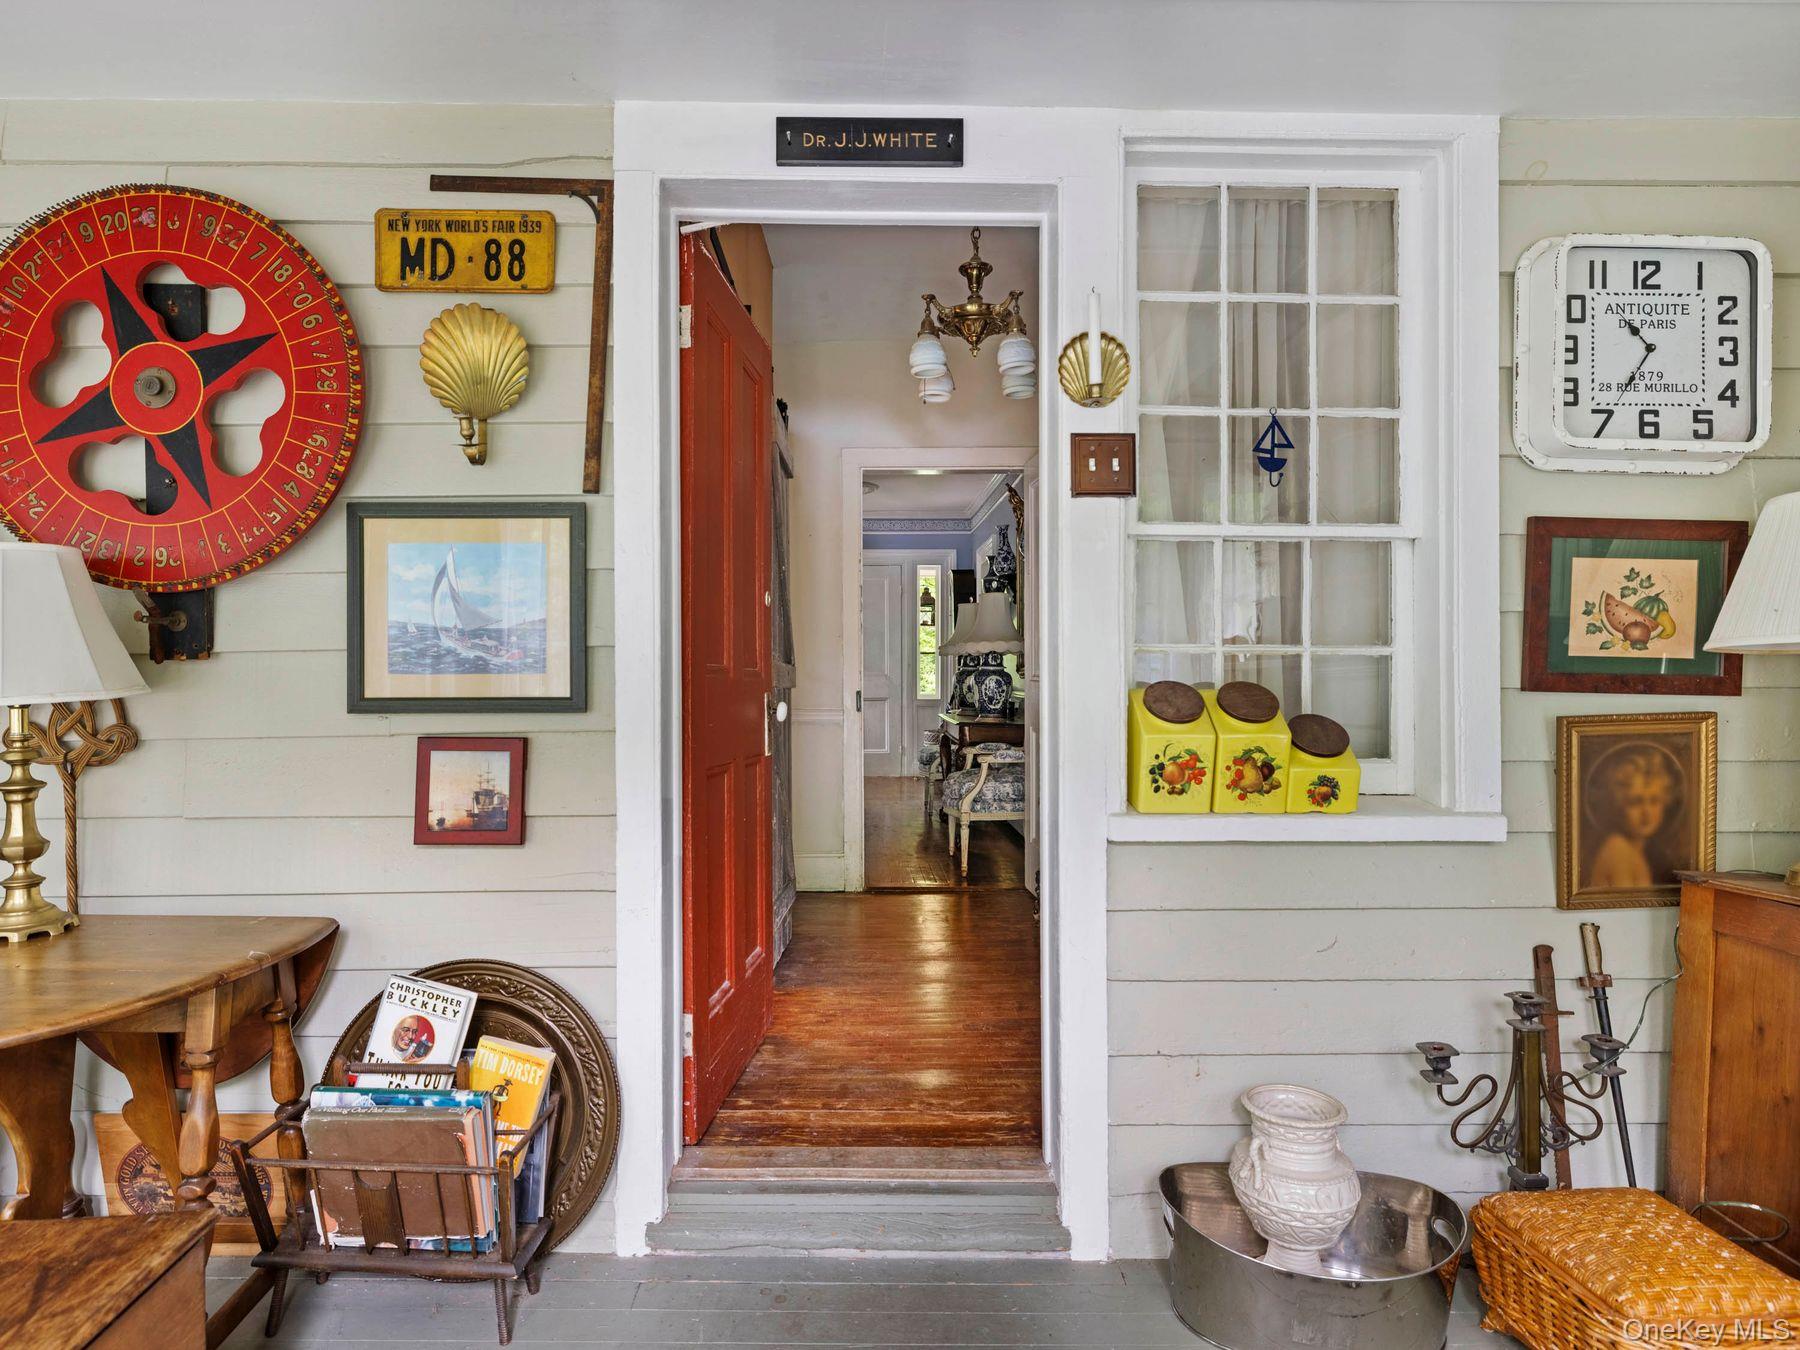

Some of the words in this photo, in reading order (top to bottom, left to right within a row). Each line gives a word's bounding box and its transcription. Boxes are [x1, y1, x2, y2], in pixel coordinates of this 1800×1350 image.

[79, 222, 94, 243] 9
[100, 211, 128, 235] 20
[388, 218, 410, 232] NEW
[415, 219, 441, 232] YORK
[445, 219, 488, 233] WORLD'S
[492, 219, 515, 233] FAIR
[519, 219, 542, 233] 1939
[249, 242, 268, 260] 7
[267, 256, 293, 283] 18
[1589, 260, 1607, 289] 11
[1633, 260, 1661, 289] 12
[1697, 261, 1703, 290] 1
[4, 276, 28, 300] 10
[303, 313, 323, 329] 6
[1604, 302, 1691, 316] ANTIQUITE
[1717, 296, 1738, 325] 2
[1640, 319, 1677, 330] PARIS
[1719, 337, 1738, 366] 3
[1598, 383, 1612, 392] 28
[1616, 383, 1641, 392] RUE
[1644, 383, 1699, 394] MURILLO
[1717, 379, 1739, 408] 4
[1591, 409, 1614, 438] 7
[1638, 410, 1660, 440] 6
[1693, 410, 1714, 440] 5
[282, 481, 300, 499] 4
[386, 991, 460, 1018] BUCKLEY
[389, 982, 462, 1008] CHRISTOPHER
[477, 1049, 499, 1072] TIM
[499, 1055, 544, 1085] DORSEY
[120, 1157, 138, 1186] GOLD
